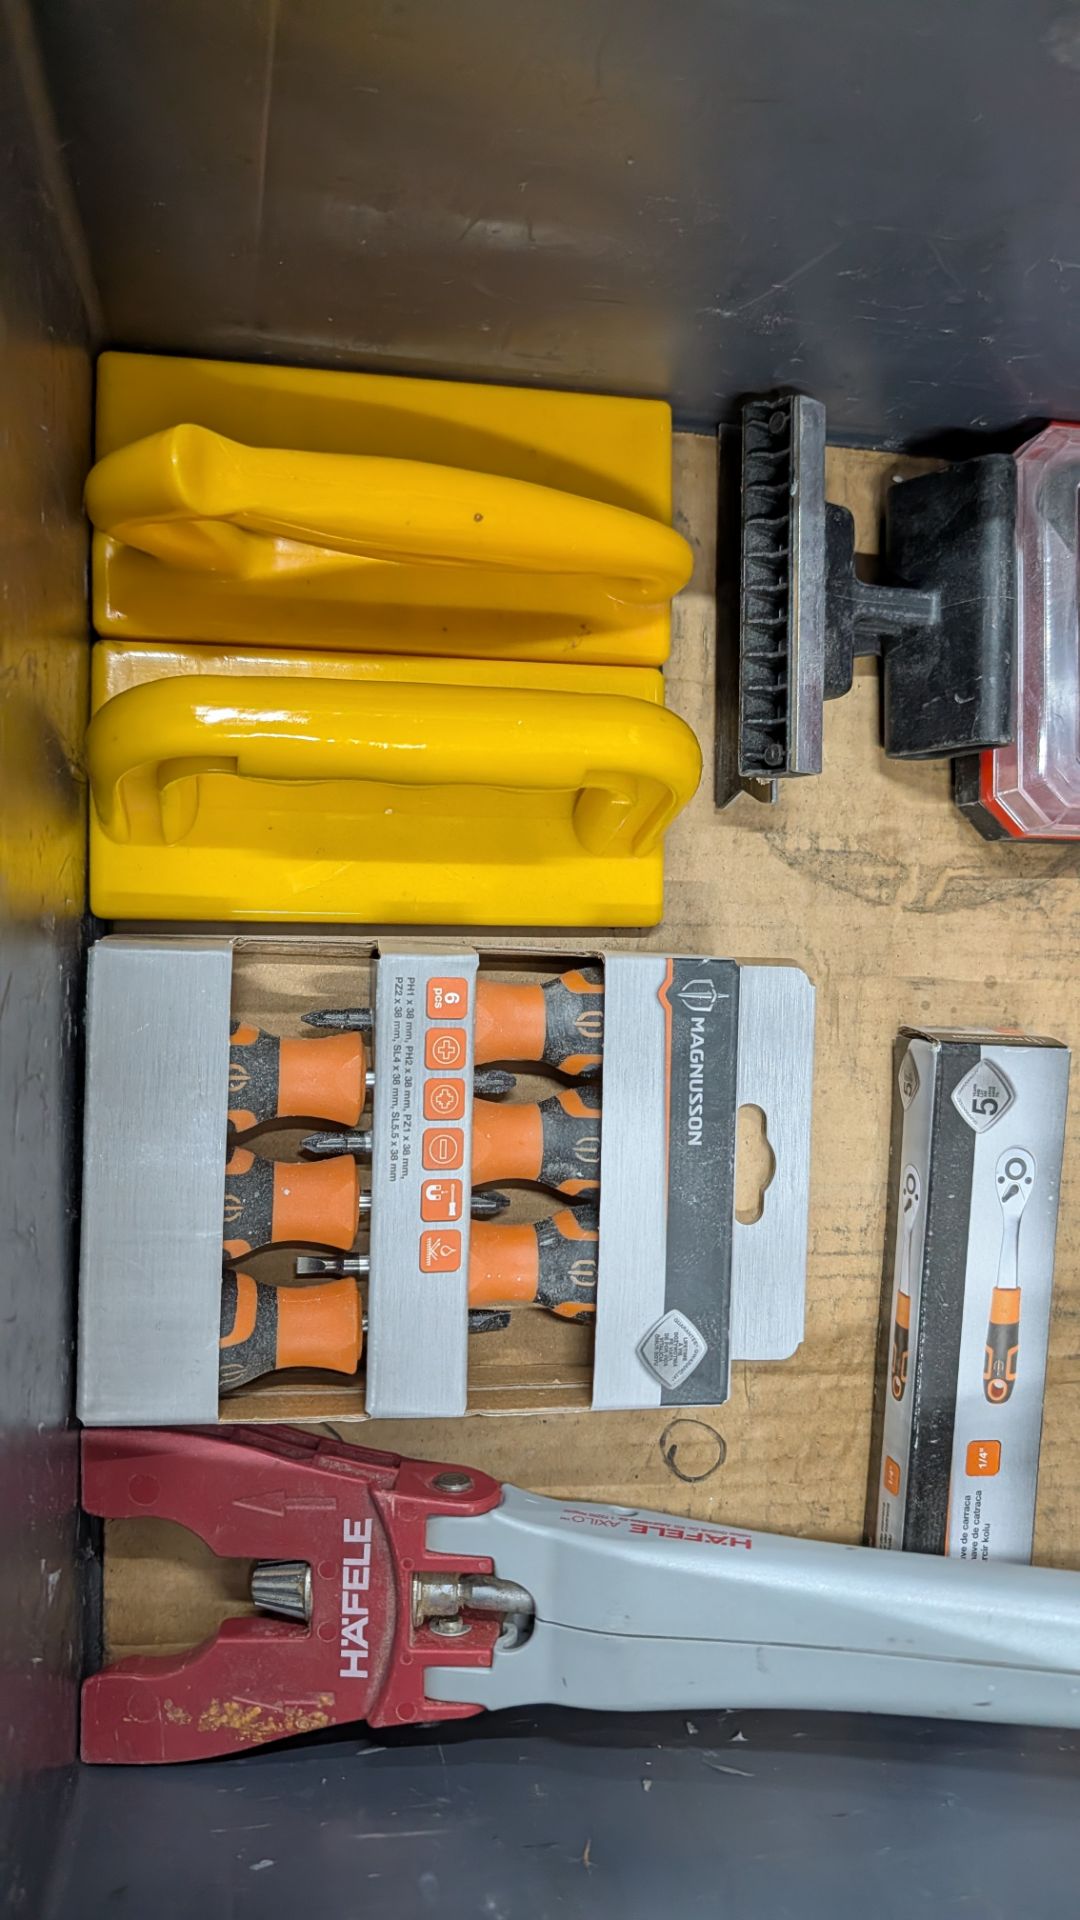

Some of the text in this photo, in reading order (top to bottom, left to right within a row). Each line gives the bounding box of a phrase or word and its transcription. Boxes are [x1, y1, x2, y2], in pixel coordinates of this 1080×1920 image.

[395, 977, 403, 996] PZ2
[406, 977, 416, 996] PH1
[433, 988, 442, 1009] pcs
[444, 992, 460, 1004] 6
[394, 1007, 402, 1018] 38
[406, 1007, 415, 1019] 38
[392, 1021, 400, 1042] mm,
[404, 1022, 412, 1043] mm,
[393, 1045, 401, 1063] SL4
[405, 1046, 414, 1066] PH2
[393, 1074, 401, 1085] 38
[404, 1076, 412, 1088] 38
[688, 1017, 705, 1146] MAGNUSSON
[390, 1088, 398, 1109] mm,
[972, 1098, 998, 1116] 5
[391, 1112, 400, 1138] SL5.5
[403, 1114, 412, 1132] PZ1
[390, 1150, 398, 1161] 38
[403, 1144, 411, 1156] 38
[389, 1164, 397, 1182] mm
[963, 1495, 971, 1530] carraca
[974, 1490, 982, 1525] catraca
[960, 1532, 968, 1544] de
[972, 1527, 979, 1539] de
[981, 1523, 991, 1543] kolu
[340, 1518, 373, 1678] HÄFELE
